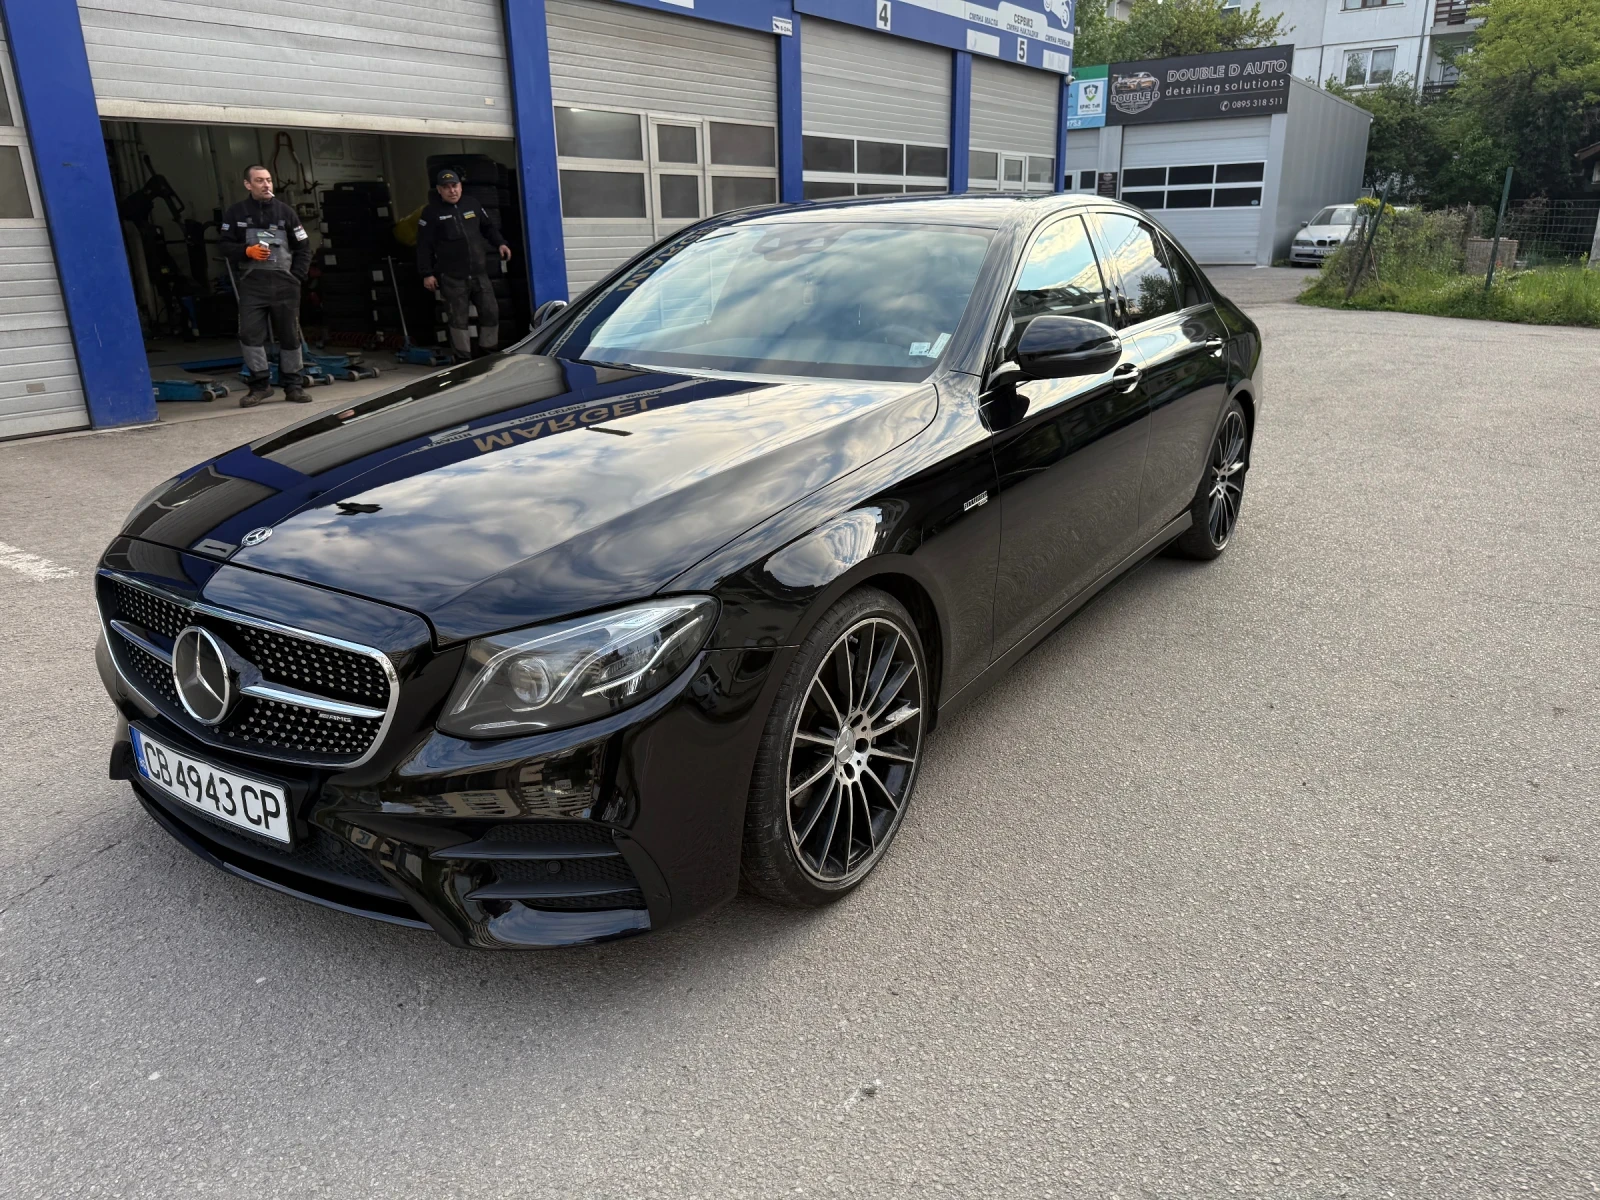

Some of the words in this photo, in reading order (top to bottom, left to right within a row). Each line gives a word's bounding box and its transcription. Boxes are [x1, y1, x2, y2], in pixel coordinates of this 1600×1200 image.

[878, 3, 889, 27] 4
[1013, 13, 1034, 28] СЕРВИЗ
[1018, 41, 1026, 60] 5
[1166, 65, 1226, 82] DOUBLE
[1228, 63, 1241, 77] D
[1243, 59, 1288, 75] AUTO
[1165, 84, 1221, 96] detailing
[1224, 78, 1285, 91] solutions
[1110, 92, 1151, 104] DOUBLE
[1152, 91, 1160, 100] D
[1232, 100, 1251, 109] 0895
[1252, 99, 1267, 107] 318
[1268, 97, 1283, 106] 511
[328, 714, 352, 723] AMG
[144, 741, 172, 788] CB
[176, 760, 236, 816] 4943
[241, 785, 281, 830] CP
